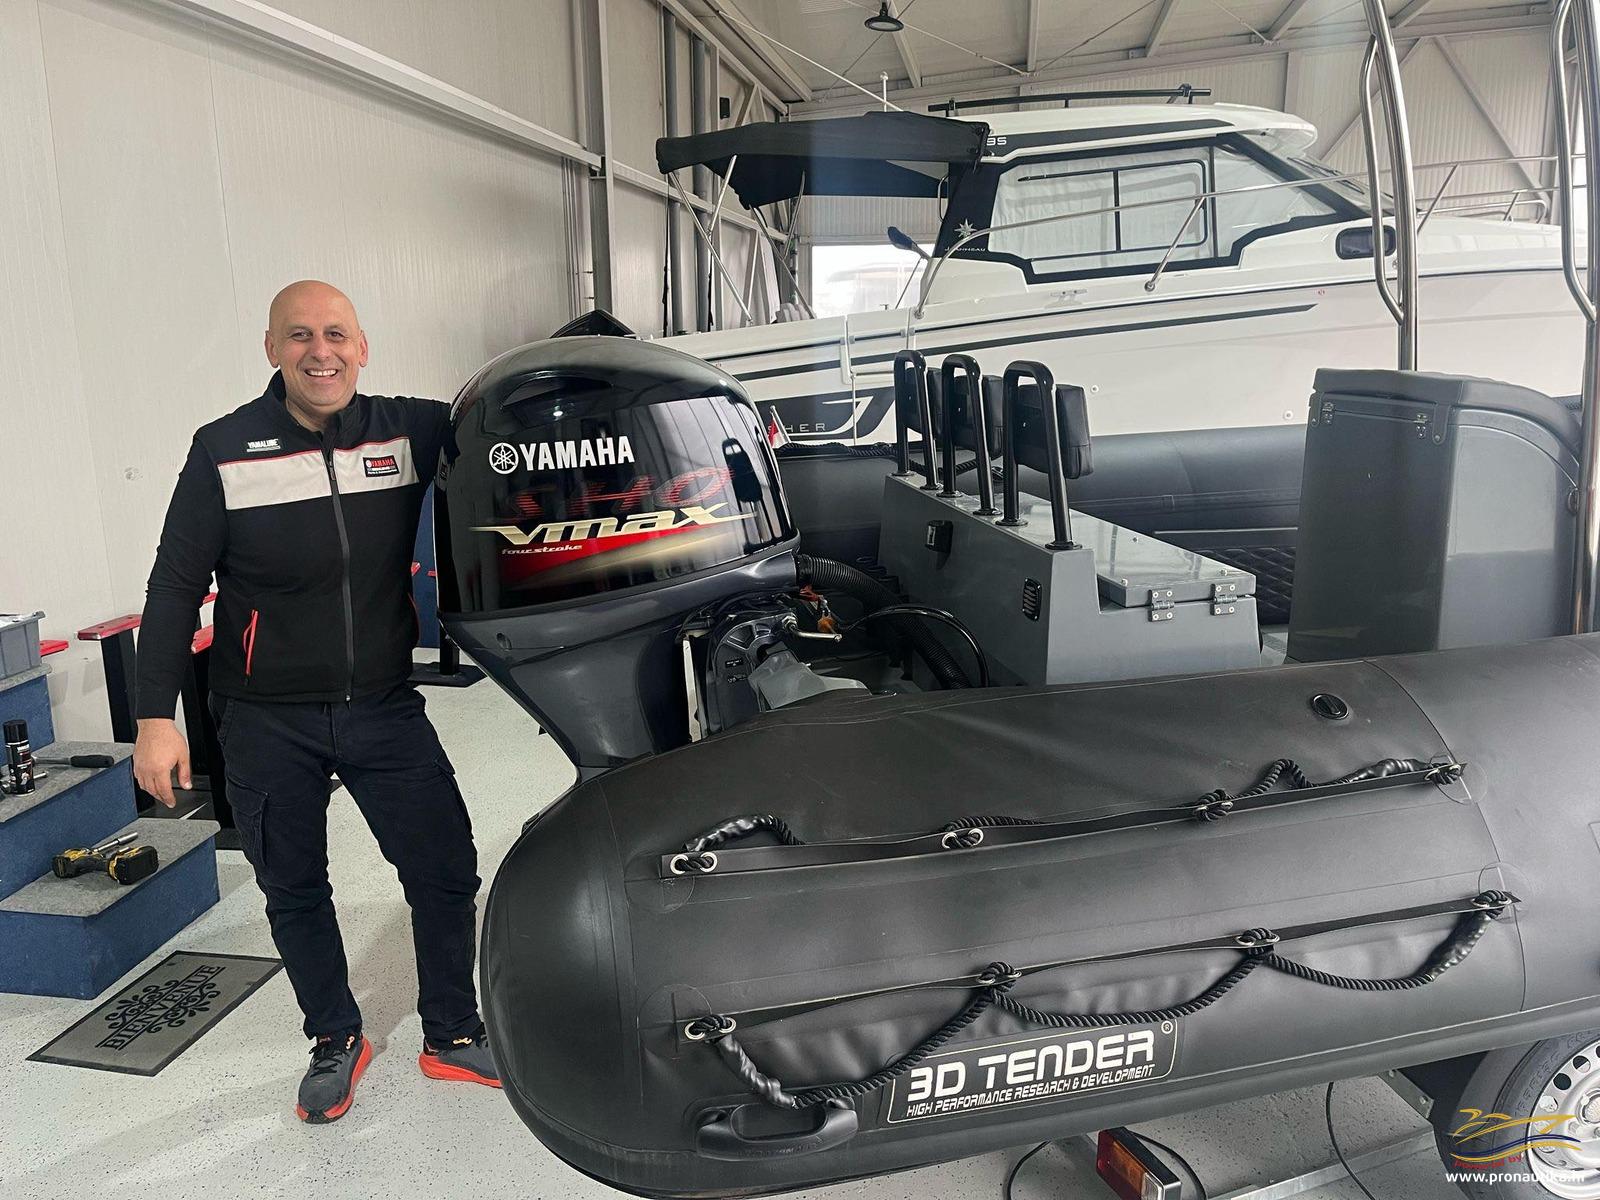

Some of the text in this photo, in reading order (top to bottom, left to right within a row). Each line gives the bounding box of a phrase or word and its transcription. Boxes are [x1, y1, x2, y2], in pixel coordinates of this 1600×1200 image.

[371, 458, 395, 467] YAMAHA
[519, 436, 635, 471] YAMAHA
[104, 965, 221, 1050] BIENVENUE
[906, 1063, 1156, 1117] HIGH PERFORMANCE RESEARCH & DEVELOPMENT
[907, 1060, 965, 1101] 3D
[978, 1030, 1156, 1089] TENDER
